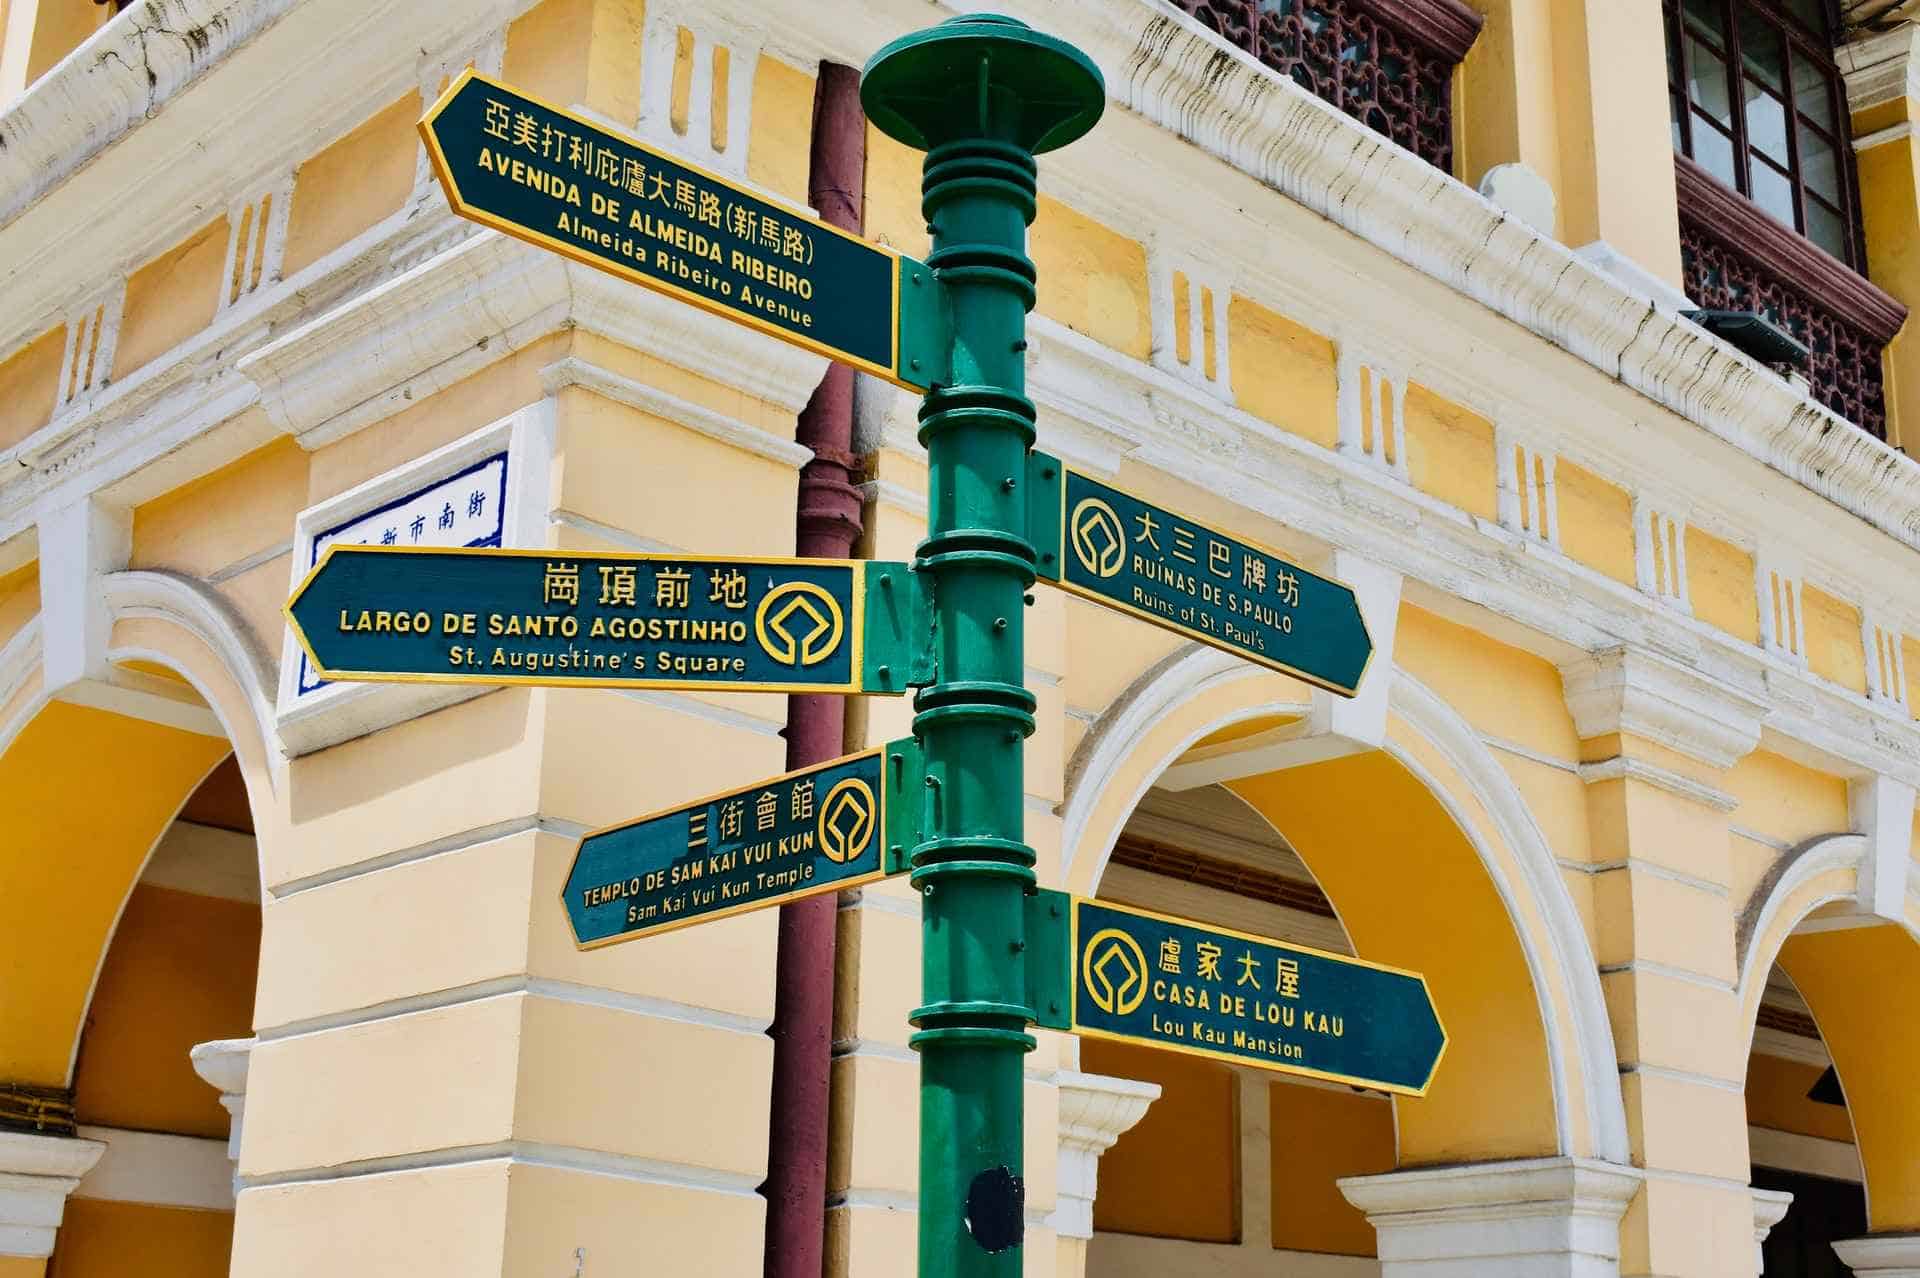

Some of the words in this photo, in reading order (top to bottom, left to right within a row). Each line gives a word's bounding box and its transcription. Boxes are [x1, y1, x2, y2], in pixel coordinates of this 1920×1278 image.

[478, 148, 581, 206] AVENIDA
[591, 192, 620, 221] DE
[630, 202, 723, 264] ALMEIDA
[732, 245, 813, 300] RIBEIRO
[557, 212, 647, 262] Almeida
[657, 251, 732, 295] Ribeiro
[741, 285, 813, 328] Avenue
[359, 490, 486, 545] 新市南街
[543, 562, 749, 610] 崗頂前地
[1134, 511, 1300, 608] 大三巴牌坊
[1133, 554, 1196, 596] RUÍNAS
[1203, 583, 1222, 606] DE
[1228, 593, 1293, 634] S.PAULO
[1133, 586, 1175, 616] Ruins
[1181, 607, 1195, 623] of
[1200, 612, 1220, 633] St.
[1225, 622, 1265, 650] Paul's
[340, 610, 431, 633] LARGO
[443, 613, 477, 634] DE
[488, 615, 579, 638] SANTO
[590, 618, 747, 642] AGOSTINHO
[449, 646, 483, 665] St.
[491, 647, 645, 673] Augustine's
[658, 651, 746, 675] Square
[688, 779, 815, 848] 三街會館
[583, 877, 639, 908] TEMPLO
[646, 871, 665, 889] DE
[671, 860, 703, 886] SAM
[710, 850, 736, 874] KAI
[743, 841, 771, 866] VUI
[779, 831, 814, 857] KUN
[628, 903, 657, 923] Sam
[663, 892, 686, 913] Kai
[693, 884, 715, 906] Vui
[722, 883, 750, 901] Kun
[757, 863, 813, 892] Temple
[1158, 936, 1300, 999] 盧家大屋
[1152, 1013, 1184, 1037] Lou
[1192, 1022, 1225, 1045] Kau
[1233, 1029, 1303, 1059] Mansion
[1153, 980, 1210, 1011] CASA
[1220, 994, 1245, 1017] DE
[1255, 999, 1295, 1028] LOU
[1304, 1010, 1344, 1037] KAU
